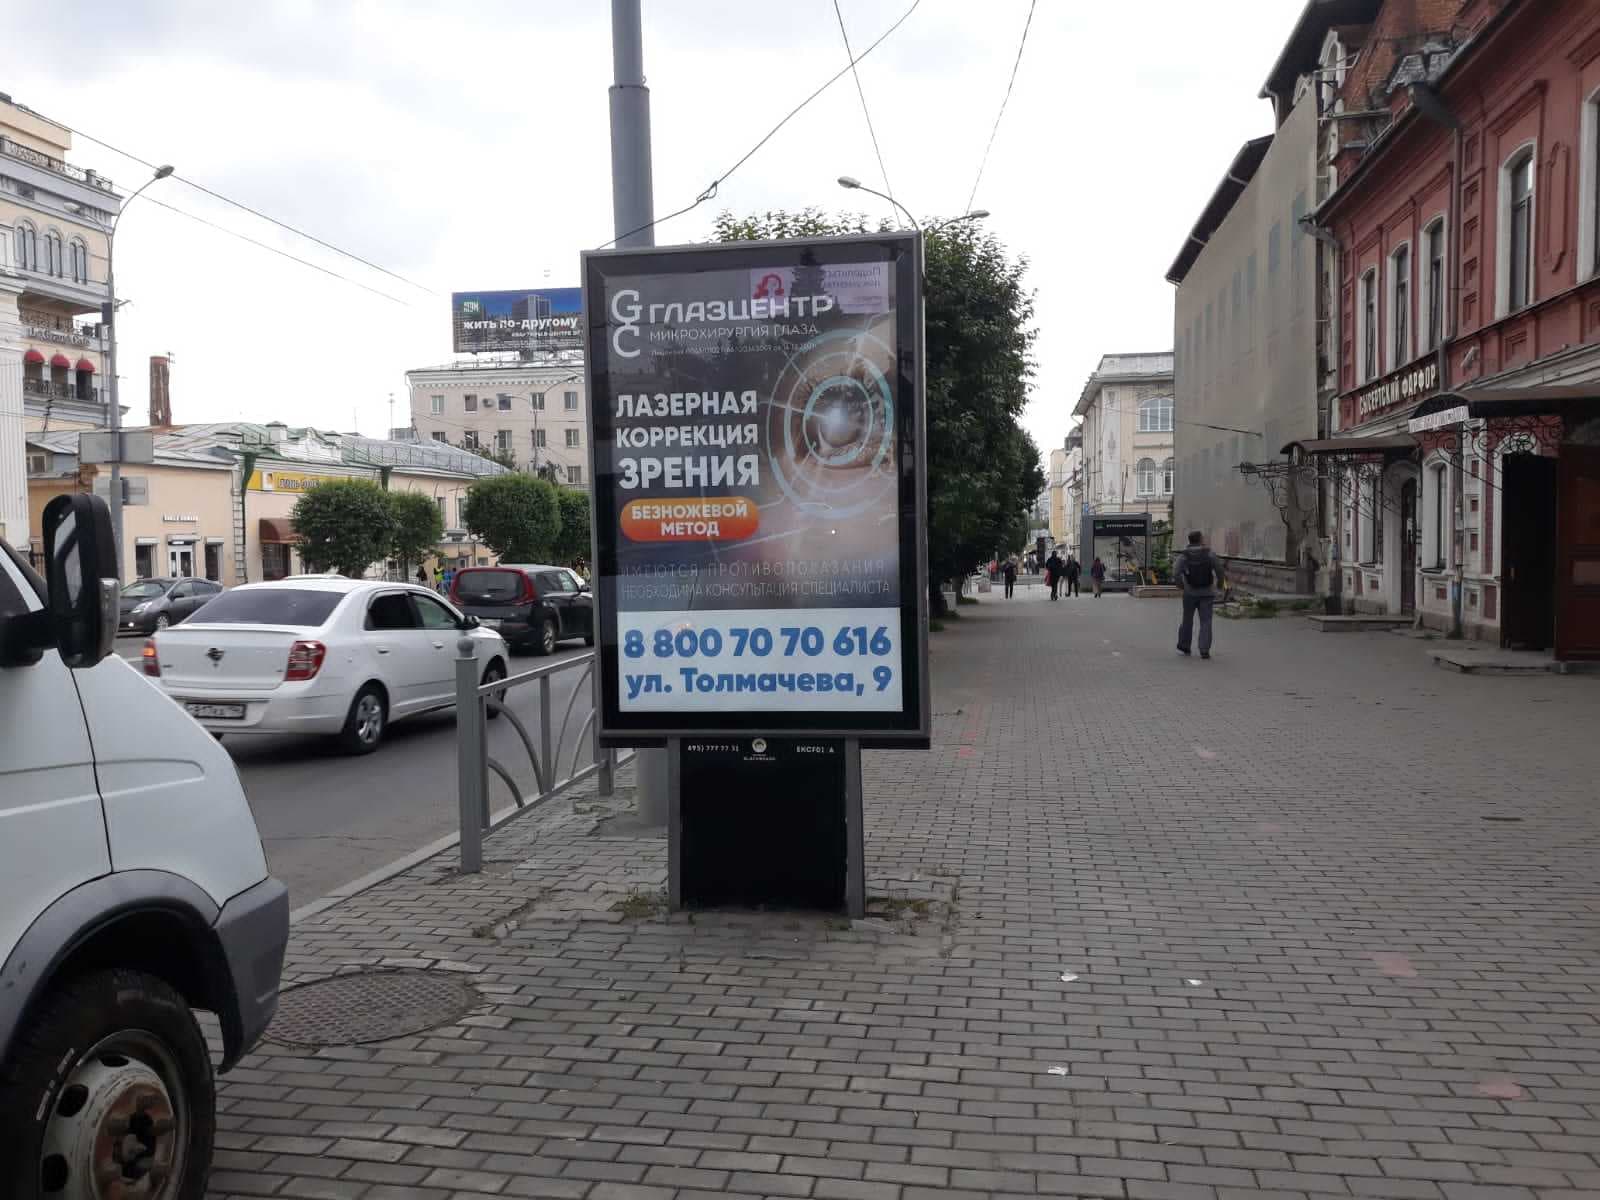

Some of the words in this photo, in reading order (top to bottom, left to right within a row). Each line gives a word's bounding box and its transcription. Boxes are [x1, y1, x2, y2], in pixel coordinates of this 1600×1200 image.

[649, 295, 833, 324] ГЛАЗЦЕНТР
[463, 320, 496, 330] жить
[499, 317, 578, 330] по-другому
[649, 325, 769, 343] МИКРОХИРУРГИЯ
[773, 323, 818, 338] ГЛАЗА
[1359, 376, 1400, 416] СЫСЕРТСКИЙ
[1401, 364, 1436, 398] ФАРФОР
[616, 390, 758, 418] ЛАЗЕРНАЯ
[616, 423, 758, 449] КОРРЕКЦИЯ
[618, 454, 760, 489] ЗРЕНИЯ
[631, 500, 748, 520] БЕЗНОЖЕВОЙ
[660, 521, 720, 537] МЕТОД
[708, 559, 885, 577] ПРОТИВОПОКАЗАНИЯ
[622, 583, 703, 599] НЕОБХОДИМА
[705, 581, 798, 598] КОНСУЛЬТАЦИЯ
[801, 578, 890, 596] СПЕЦИАЛИСТА
[624, 628, 645, 658] 8
[653, 628, 723, 658] 800
[730, 628, 773, 657] 70
[780, 627, 824, 656] 70
[832, 626, 892, 656] 616
[626, 672, 673, 699] ул.
[680, 667, 864, 697] Толмачева,
[872, 665, 893, 692] 9
